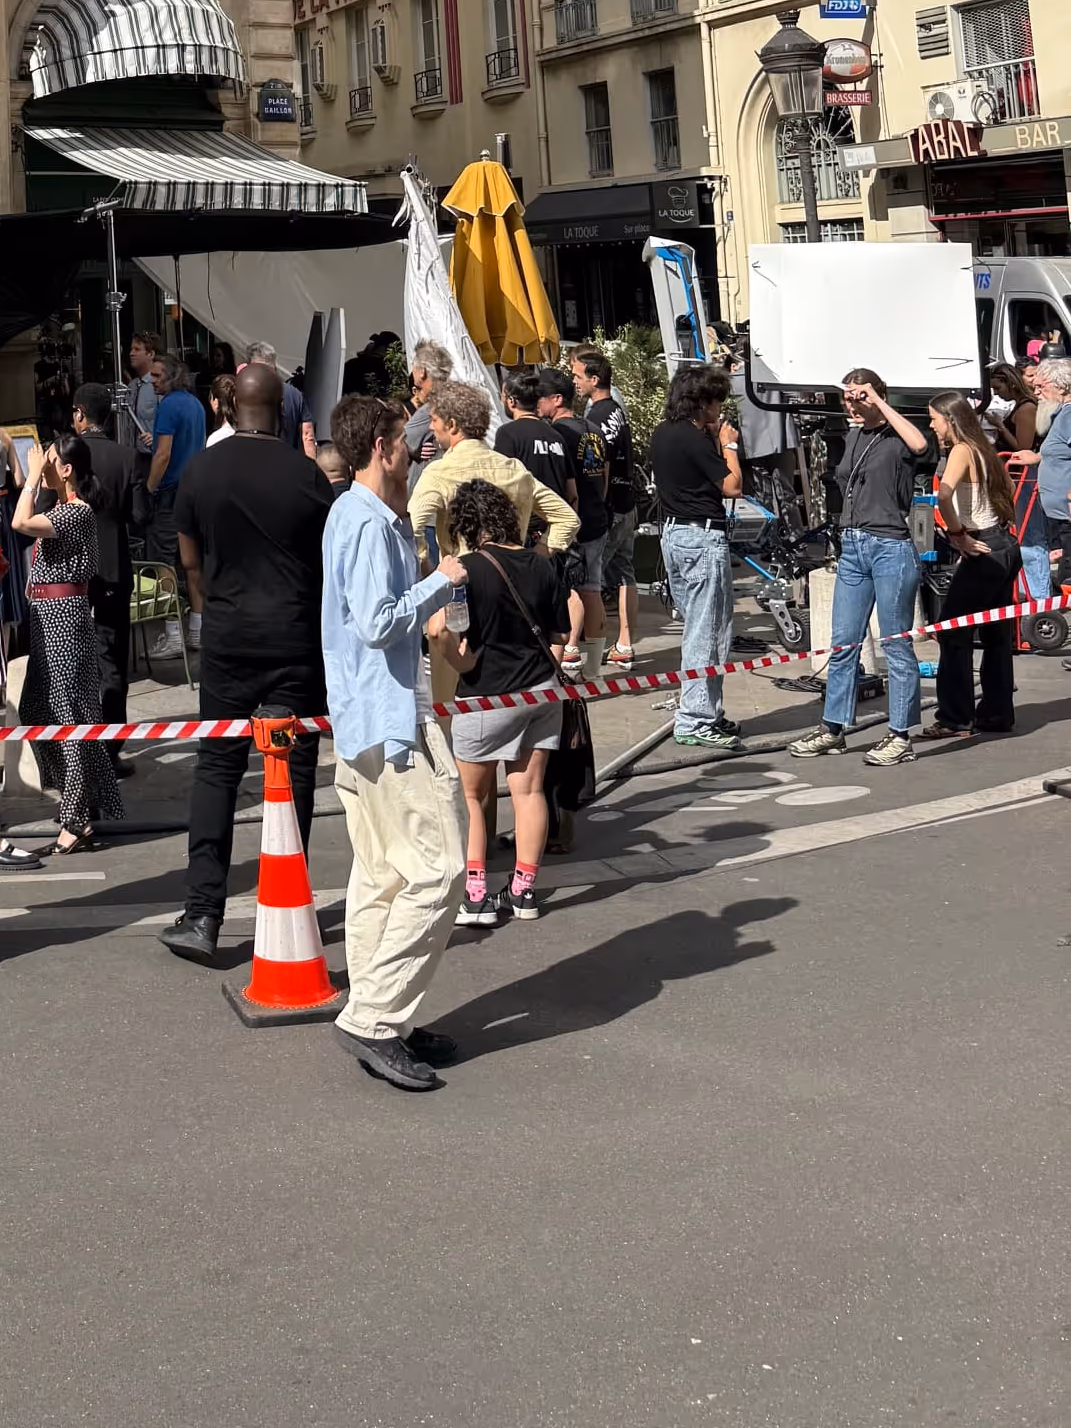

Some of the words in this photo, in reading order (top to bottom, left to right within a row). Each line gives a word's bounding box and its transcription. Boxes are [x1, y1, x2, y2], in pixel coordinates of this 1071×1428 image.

[828, 0, 848, 11] FDJ
[826, 92, 871, 104] BRASSERIE
[903, 121, 980, 164] TABAC
[1015, 121, 1062, 149] BAR
[658, 209, 668, 218] LA
[670, 208, 695, 218] TOQUE
[563, 227, 574, 239] LA
[575, 225, 599, 239] TOQUE
